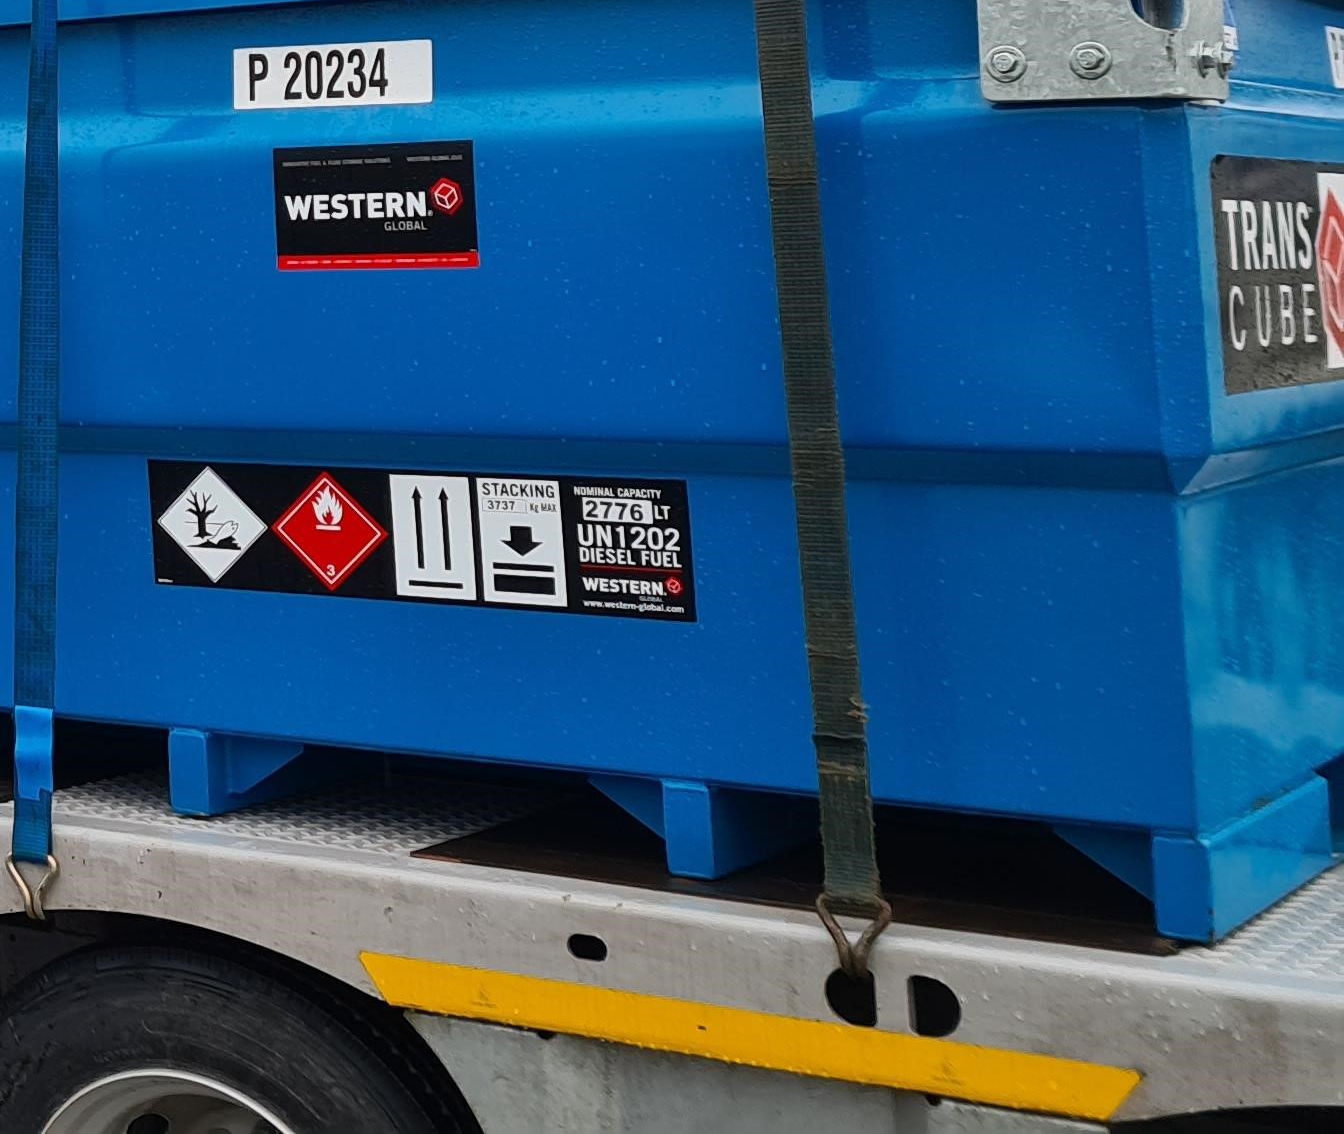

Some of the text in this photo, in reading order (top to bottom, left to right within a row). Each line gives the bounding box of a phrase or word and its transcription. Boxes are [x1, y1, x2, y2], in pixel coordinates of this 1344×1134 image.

[249, 47, 389, 102] P 20234
[284, 191, 427, 221] WESTERN
[384, 220, 427, 231] GLOBAL
[1220, 199, 1313, 271] TRANS
[1228, 283, 1318, 352] CUBE
[482, 482, 555, 499] STACKING
[573, 486, 662, 499] NOMINAL CAPACITY
[487, 500, 557, 513] 3737 Kg MAX
[585, 500, 671, 522] 2776 LT
[577, 523, 681, 551] UN1202
[579, 547, 682, 568] DIESEL FUEL
[326, 564, 336, 577] 3
[582, 577, 667, 596] WESTERN
[583, 600, 684, 614] www.western-global.com
